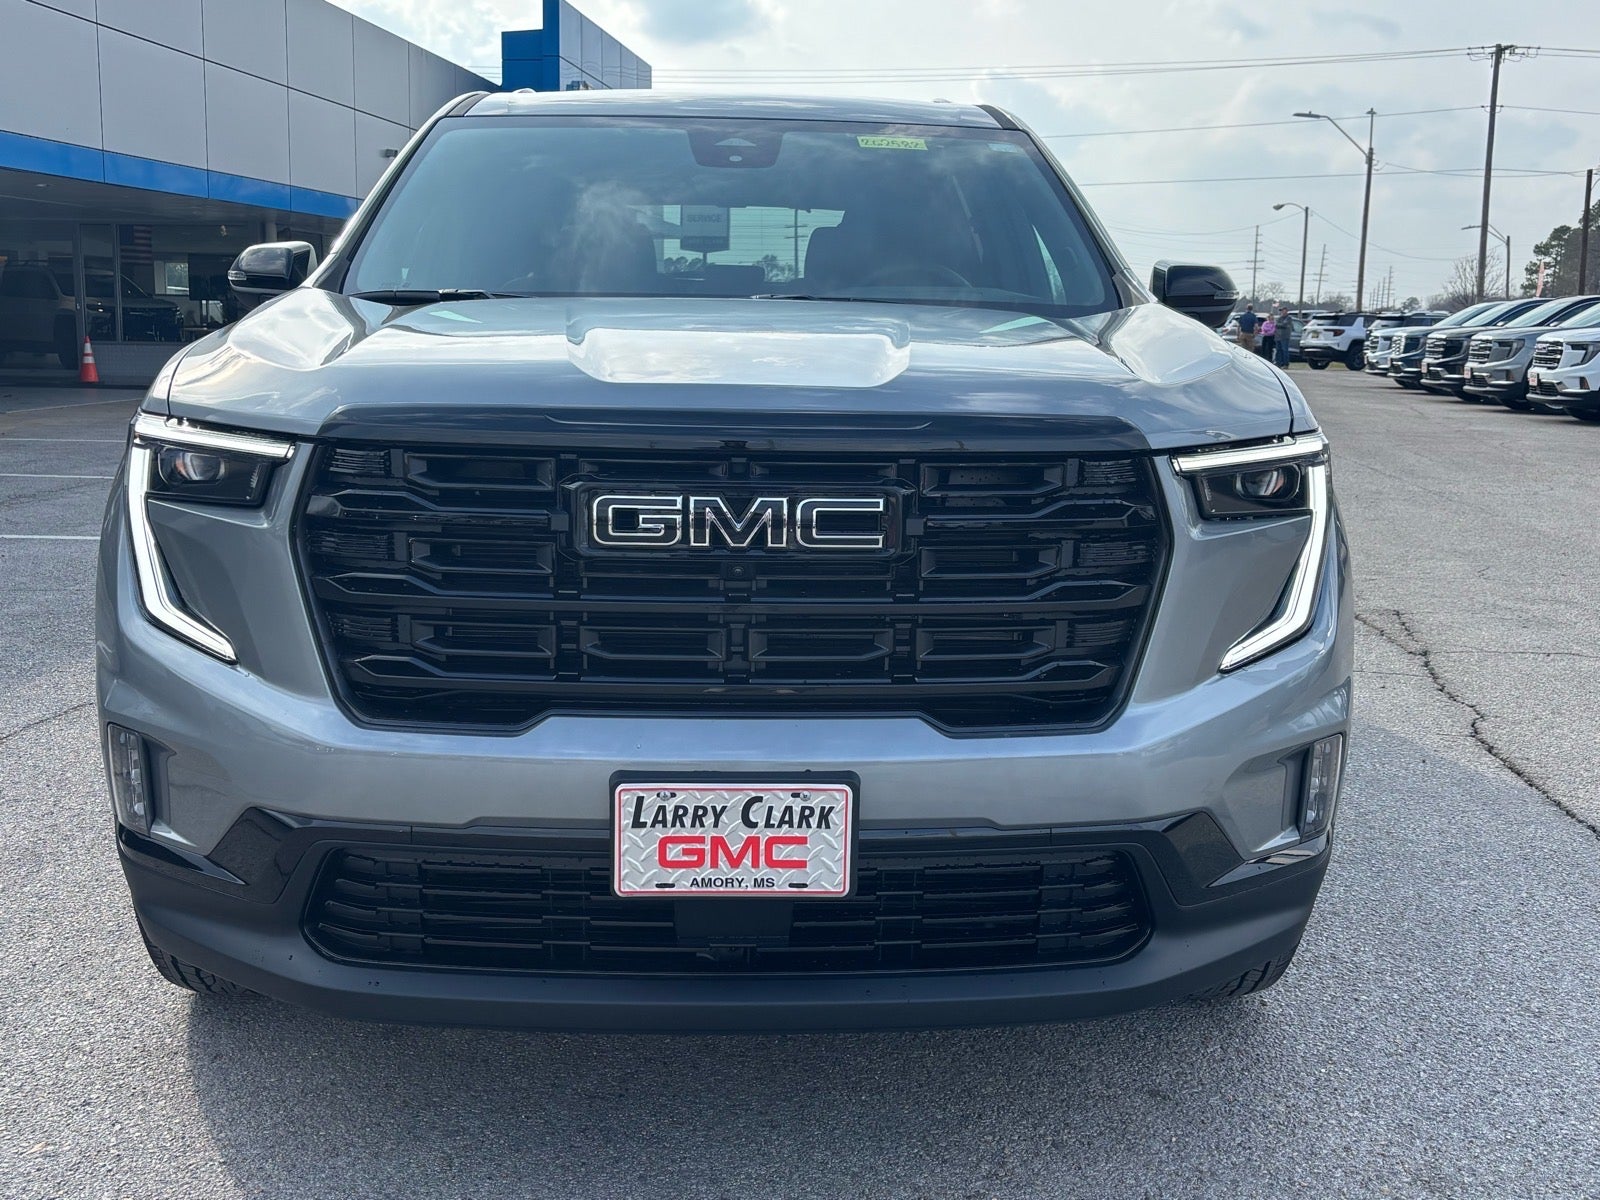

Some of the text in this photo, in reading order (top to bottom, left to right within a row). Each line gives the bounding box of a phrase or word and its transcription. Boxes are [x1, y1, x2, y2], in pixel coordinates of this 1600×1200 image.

[686, 214, 722, 223] SERVICE
[593, 494, 884, 549] GMC
[631, 795, 836, 830] LARRY CLARK
[657, 835, 809, 869] GMC
[689, 877, 776, 890] AMORY, MS
